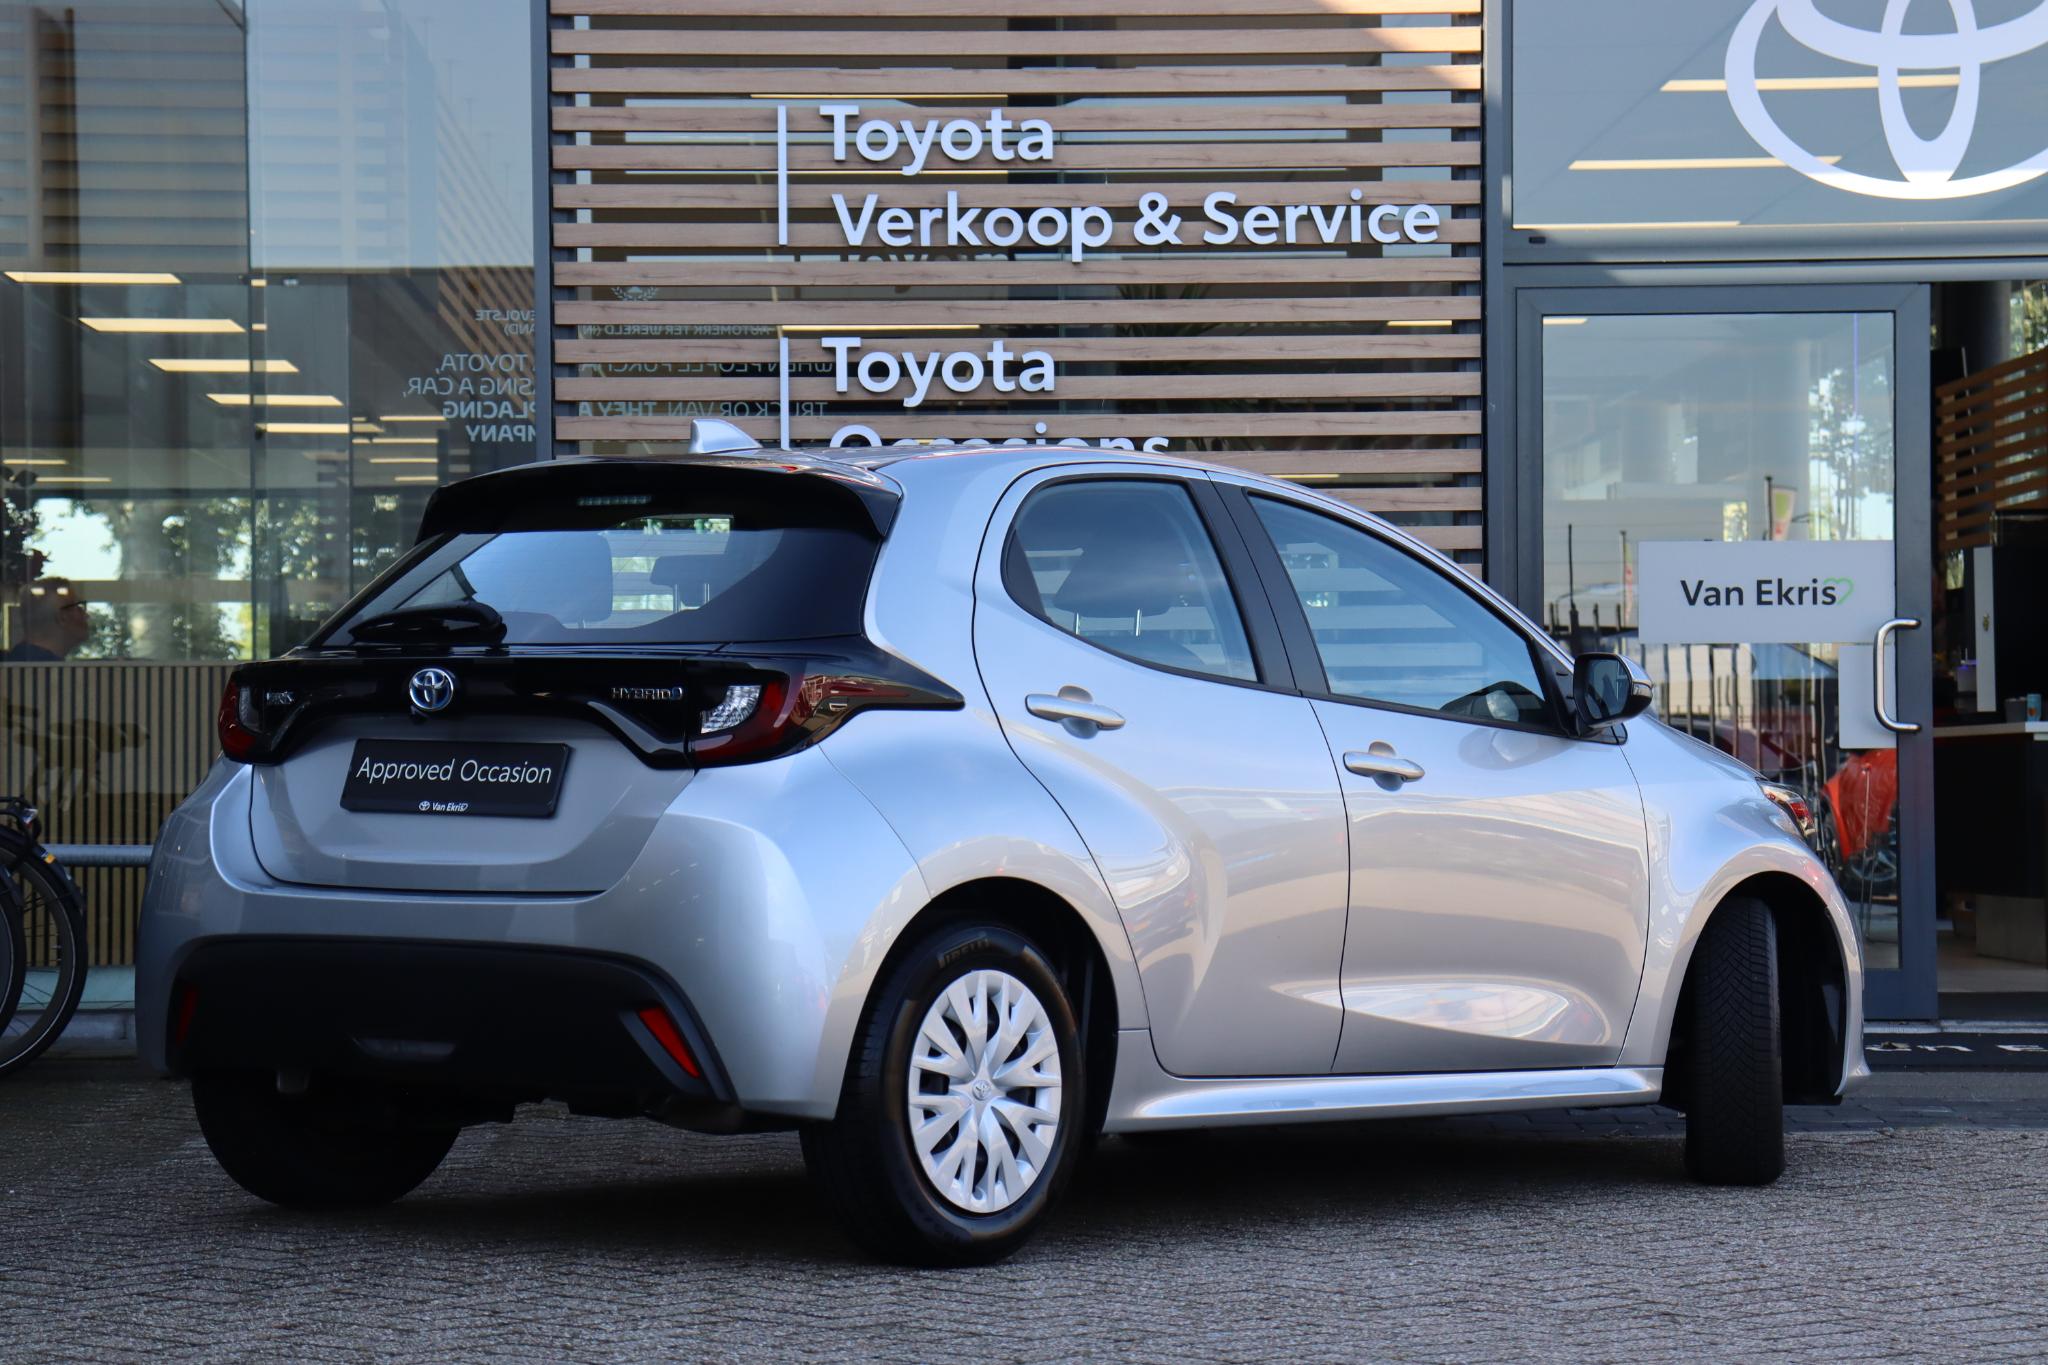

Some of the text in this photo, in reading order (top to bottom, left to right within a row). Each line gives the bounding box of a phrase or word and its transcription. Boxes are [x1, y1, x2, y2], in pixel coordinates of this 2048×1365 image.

[819, 104, 1054, 176] Toyota
[831, 188, 1440, 263] Verkoop & Service
[821, 337, 1055, 407] Toyota
[1680, 578, 1837, 606] Van Ekris
[612, 687, 671, 700] HYBRID
[356, 757, 552, 784] Approved Occasion
[432, 802, 446, 811] Van
